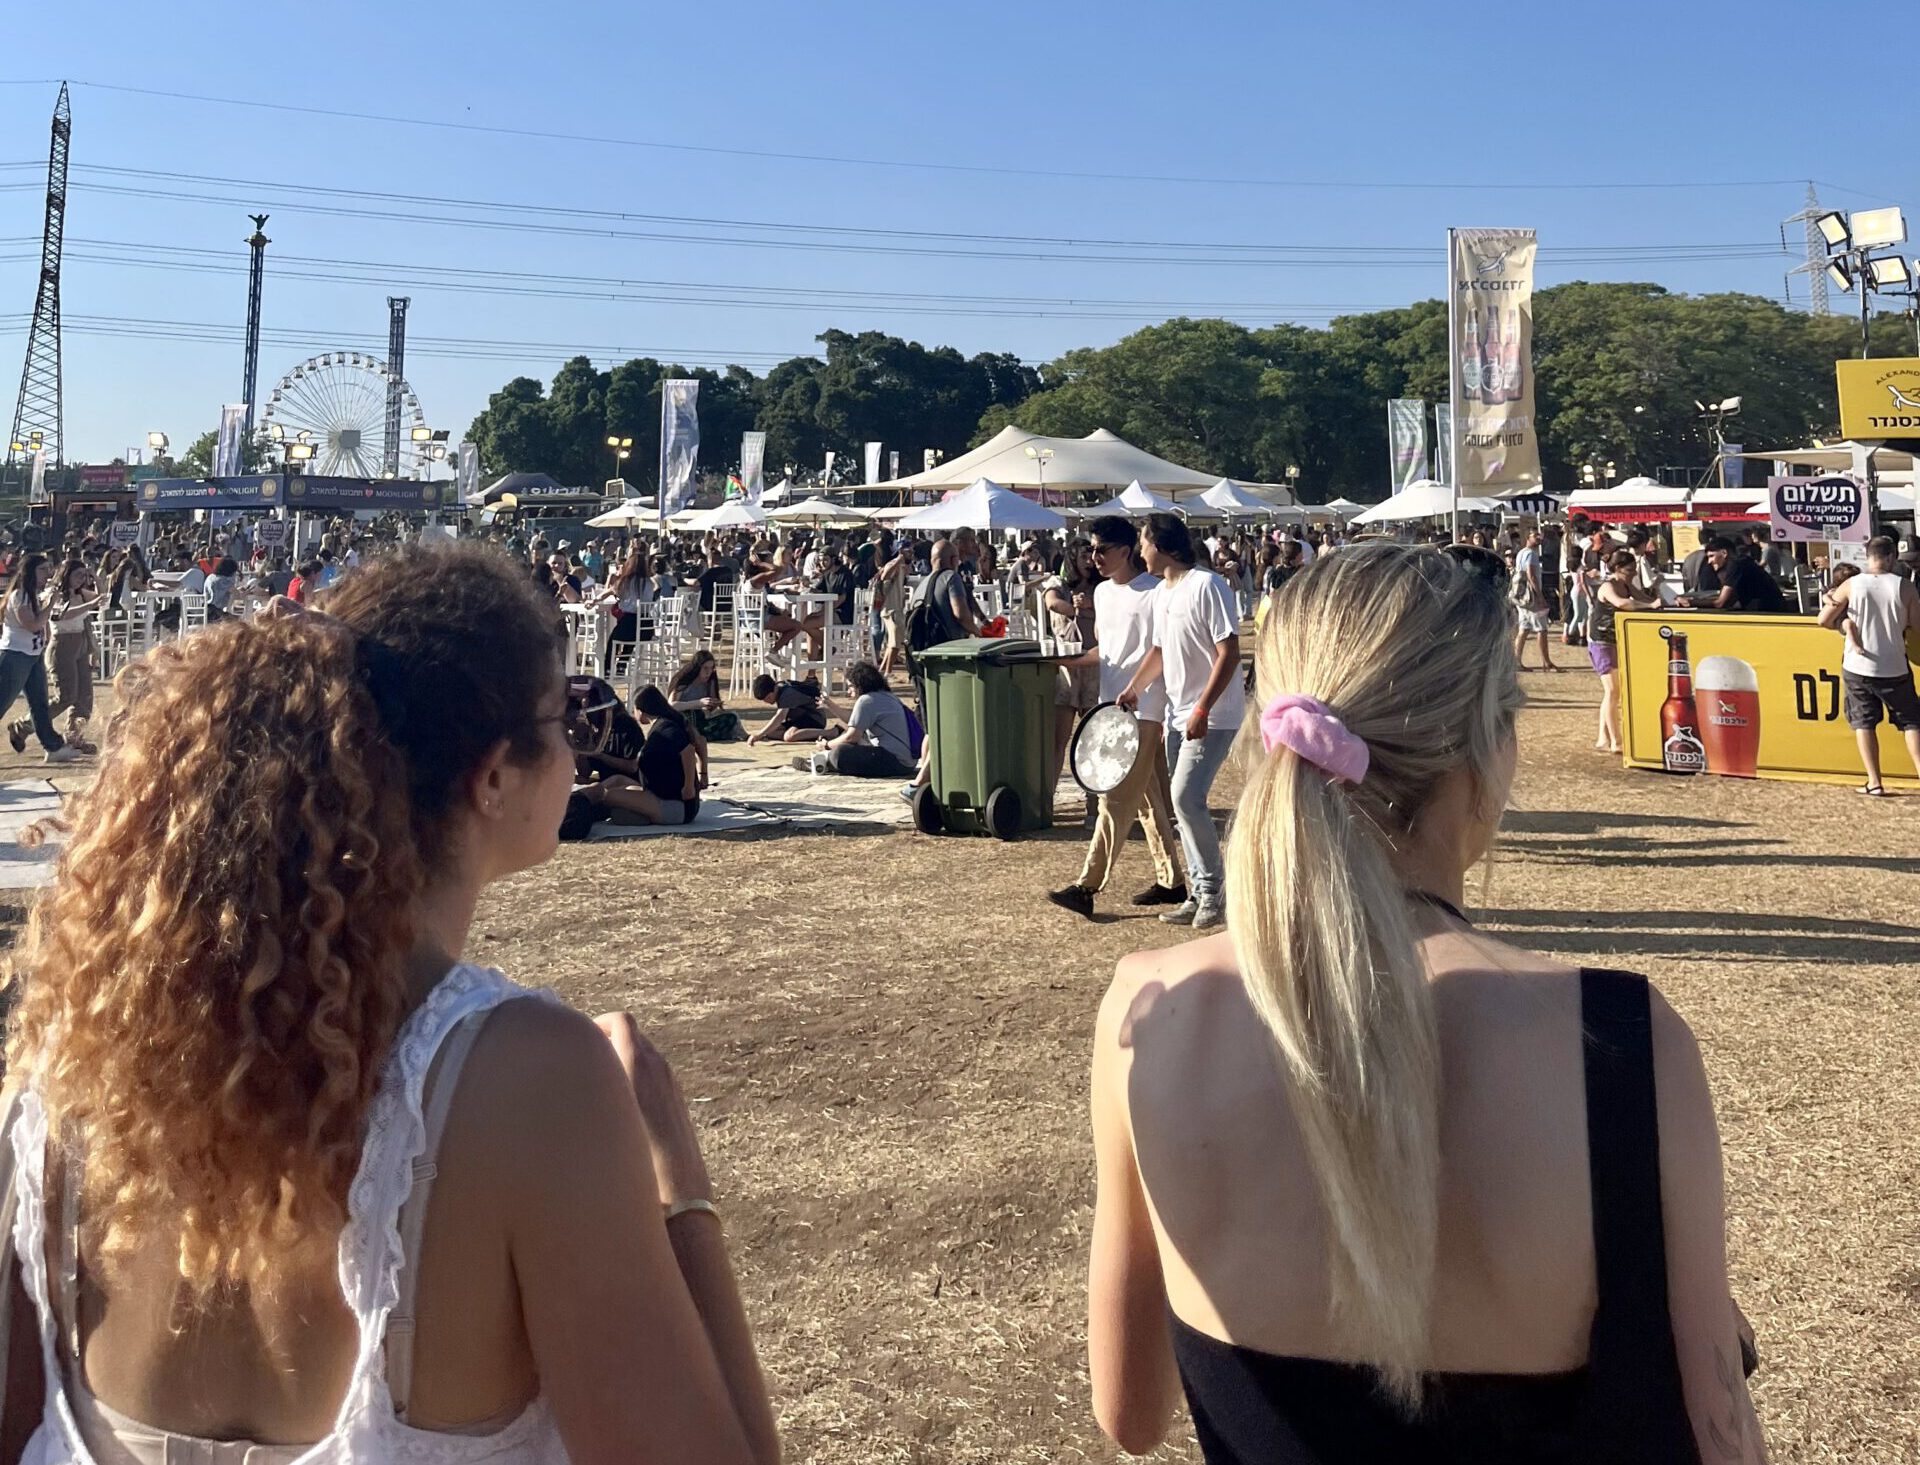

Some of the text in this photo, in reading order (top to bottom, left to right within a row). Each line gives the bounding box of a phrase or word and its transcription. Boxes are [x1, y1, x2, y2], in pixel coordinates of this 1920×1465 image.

[217, 486, 259, 495] MOONLIGHT
[375, 490, 418, 499] MOONLIGHT
[1783, 482, 1856, 503] תשלום
[1805, 504, 1856, 514] באפליקצית
[1788, 513, 1812, 523] בלבד
[1813, 514, 1848, 523] באשראי
[1793, 668, 1840, 721] לם
